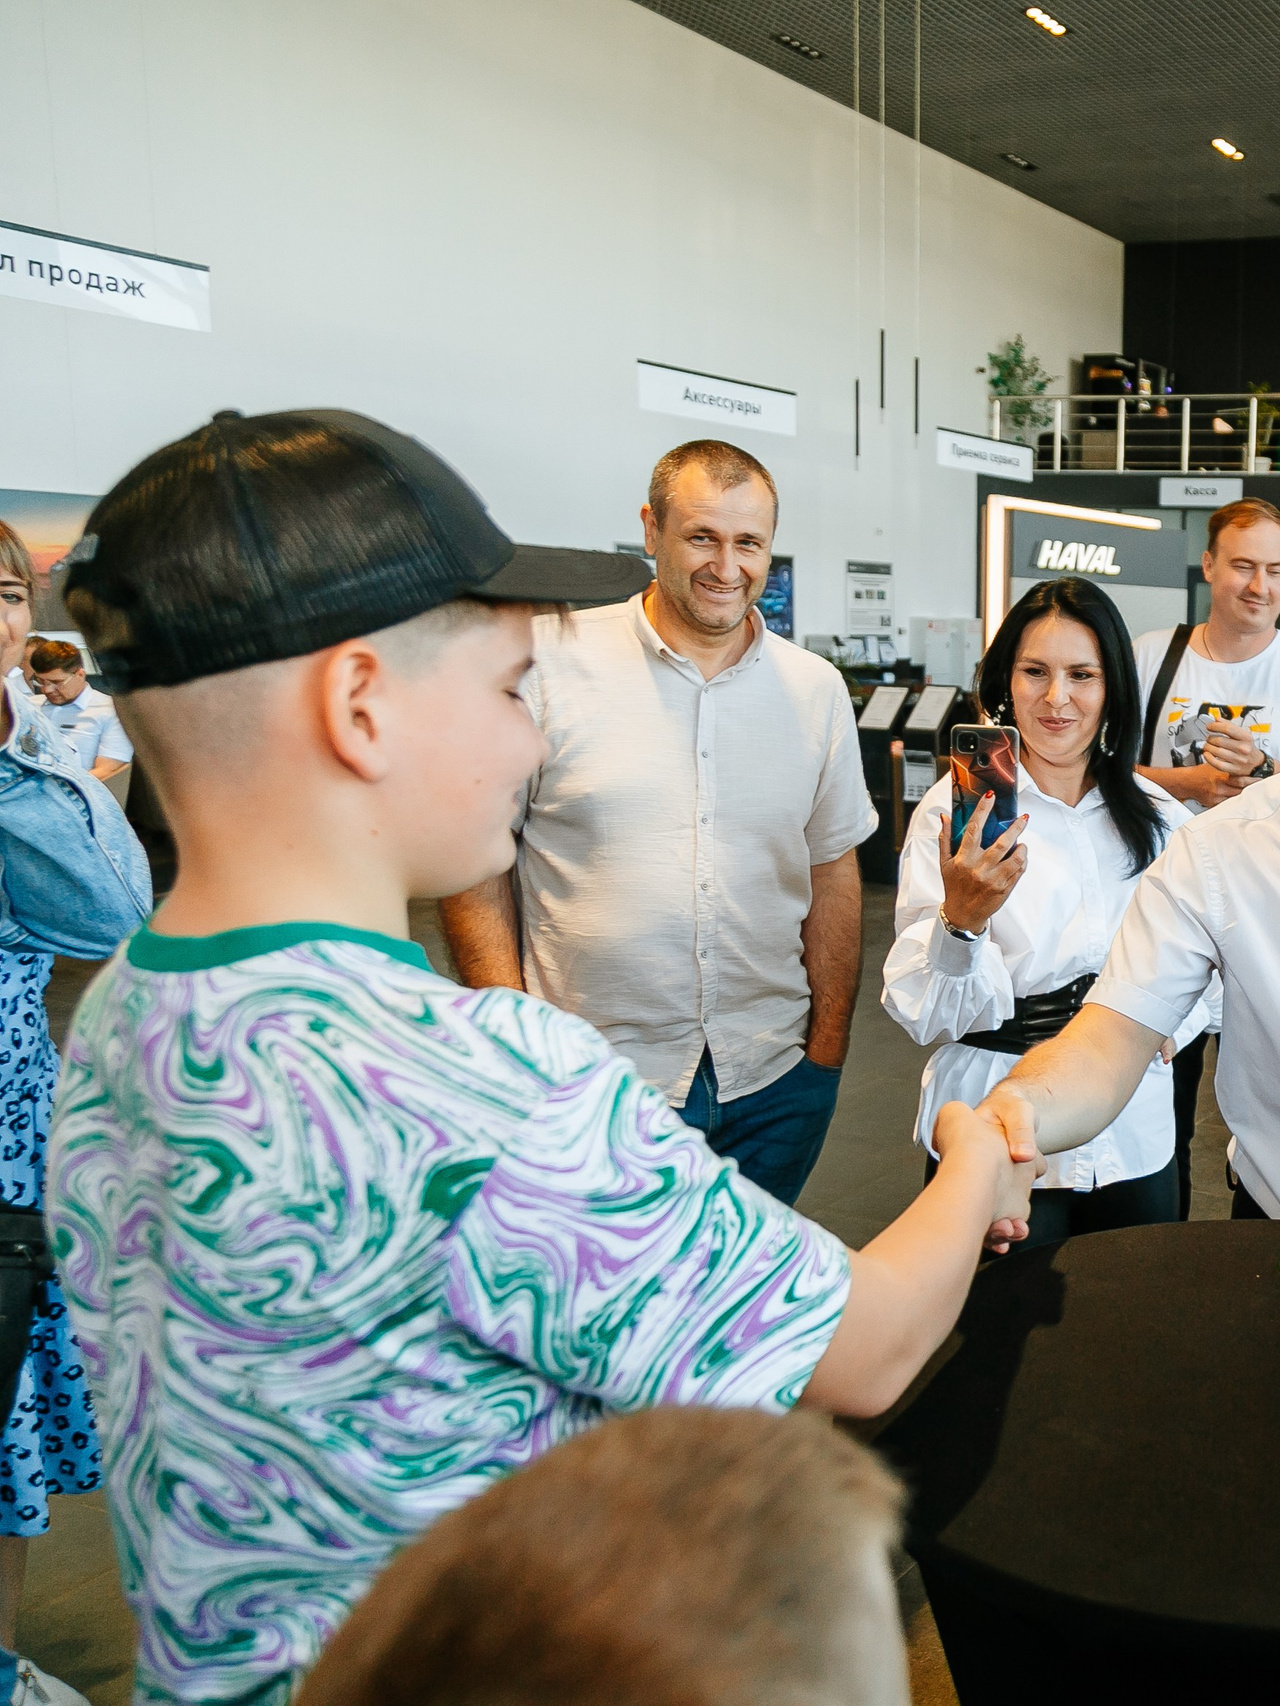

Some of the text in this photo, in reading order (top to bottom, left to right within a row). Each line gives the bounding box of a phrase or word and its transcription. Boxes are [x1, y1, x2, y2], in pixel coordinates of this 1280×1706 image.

[28, 259, 146, 298] продаж
[683, 386, 762, 415] Аксессуары
[1184, 484, 1218, 496] Касса
[1037, 539, 1121, 575] HAVAL
